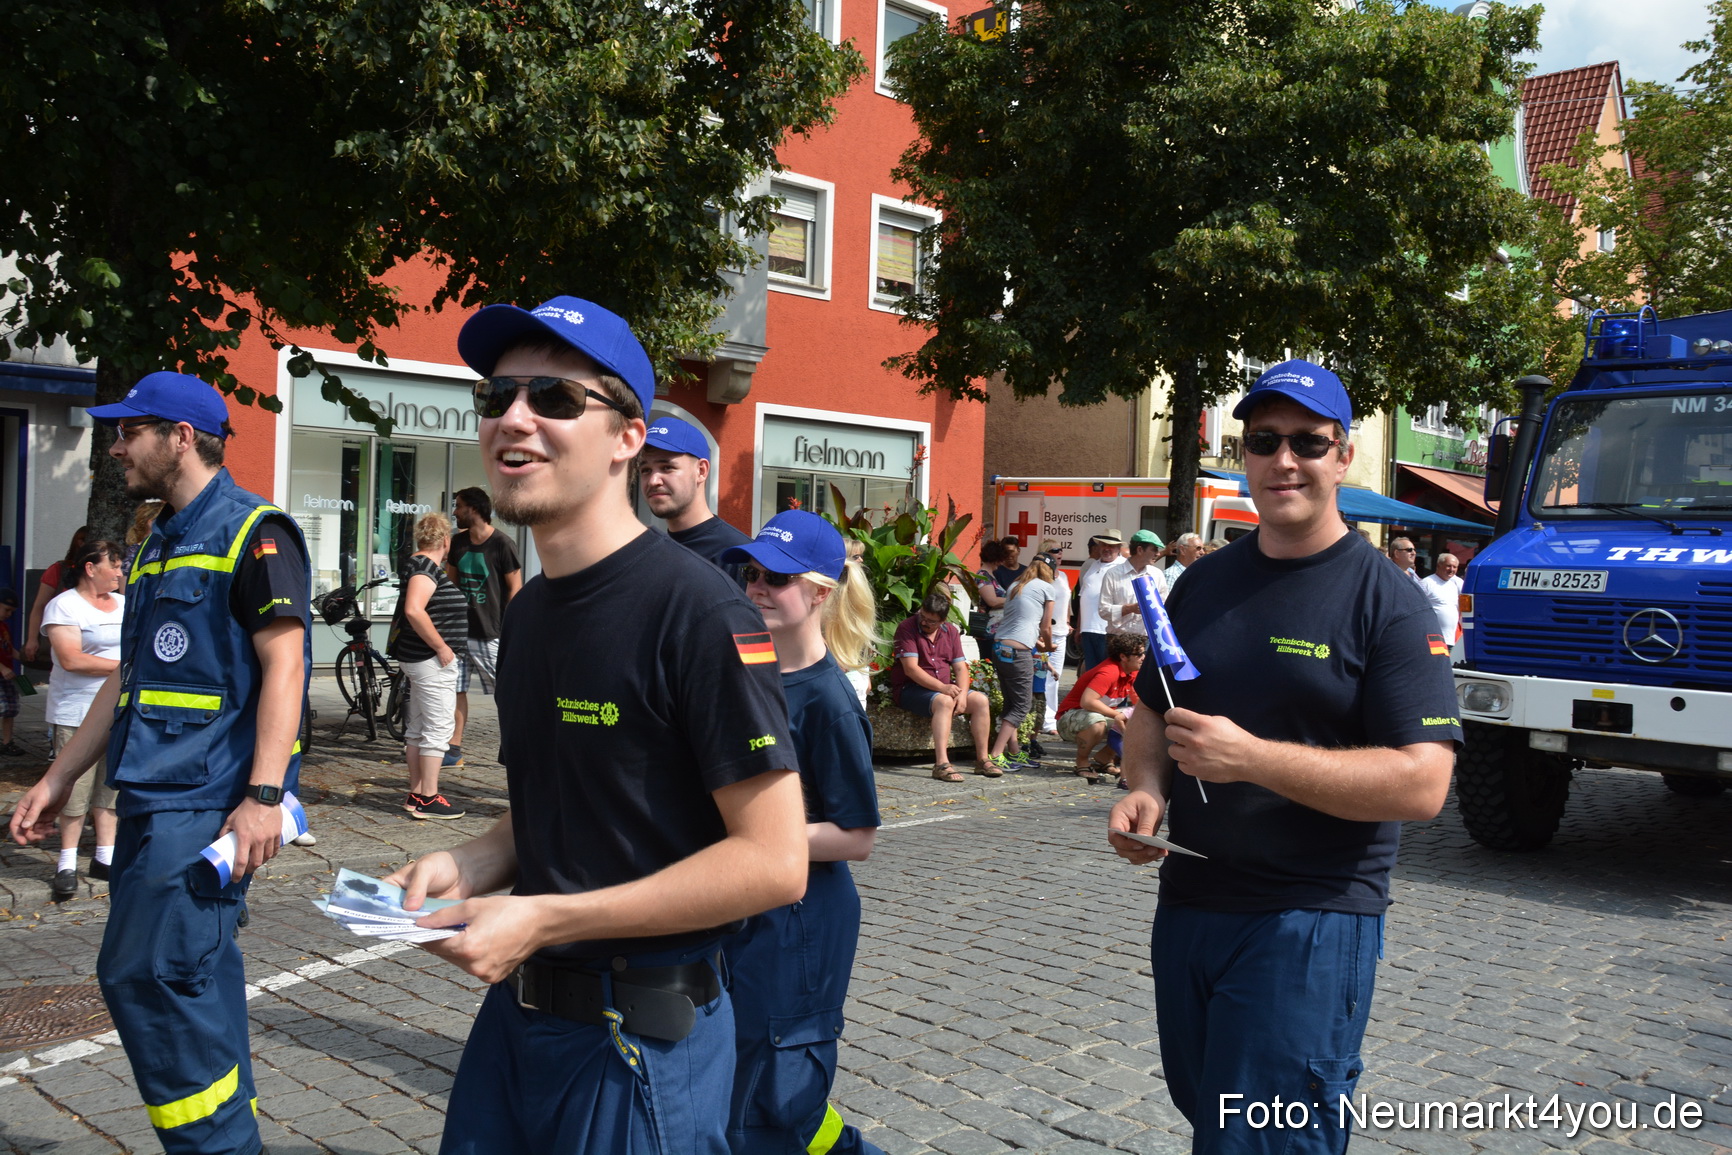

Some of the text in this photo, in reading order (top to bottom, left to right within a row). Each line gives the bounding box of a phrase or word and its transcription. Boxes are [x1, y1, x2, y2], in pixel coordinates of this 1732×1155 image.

[1671, 397, 1707, 414] NM
[1043, 511, 1108, 525] Bayerisches
[1043, 525, 1074, 536] Rotes
[1606, 547, 1732, 564] THW
[1512, 571, 1541, 587] THW
[1551, 572, 1602, 589] 82523
[1269, 636, 1315, 649] Technisches
[1276, 645, 1313, 657] Hilfswerk
[556, 697, 600, 712] Tchnisches
